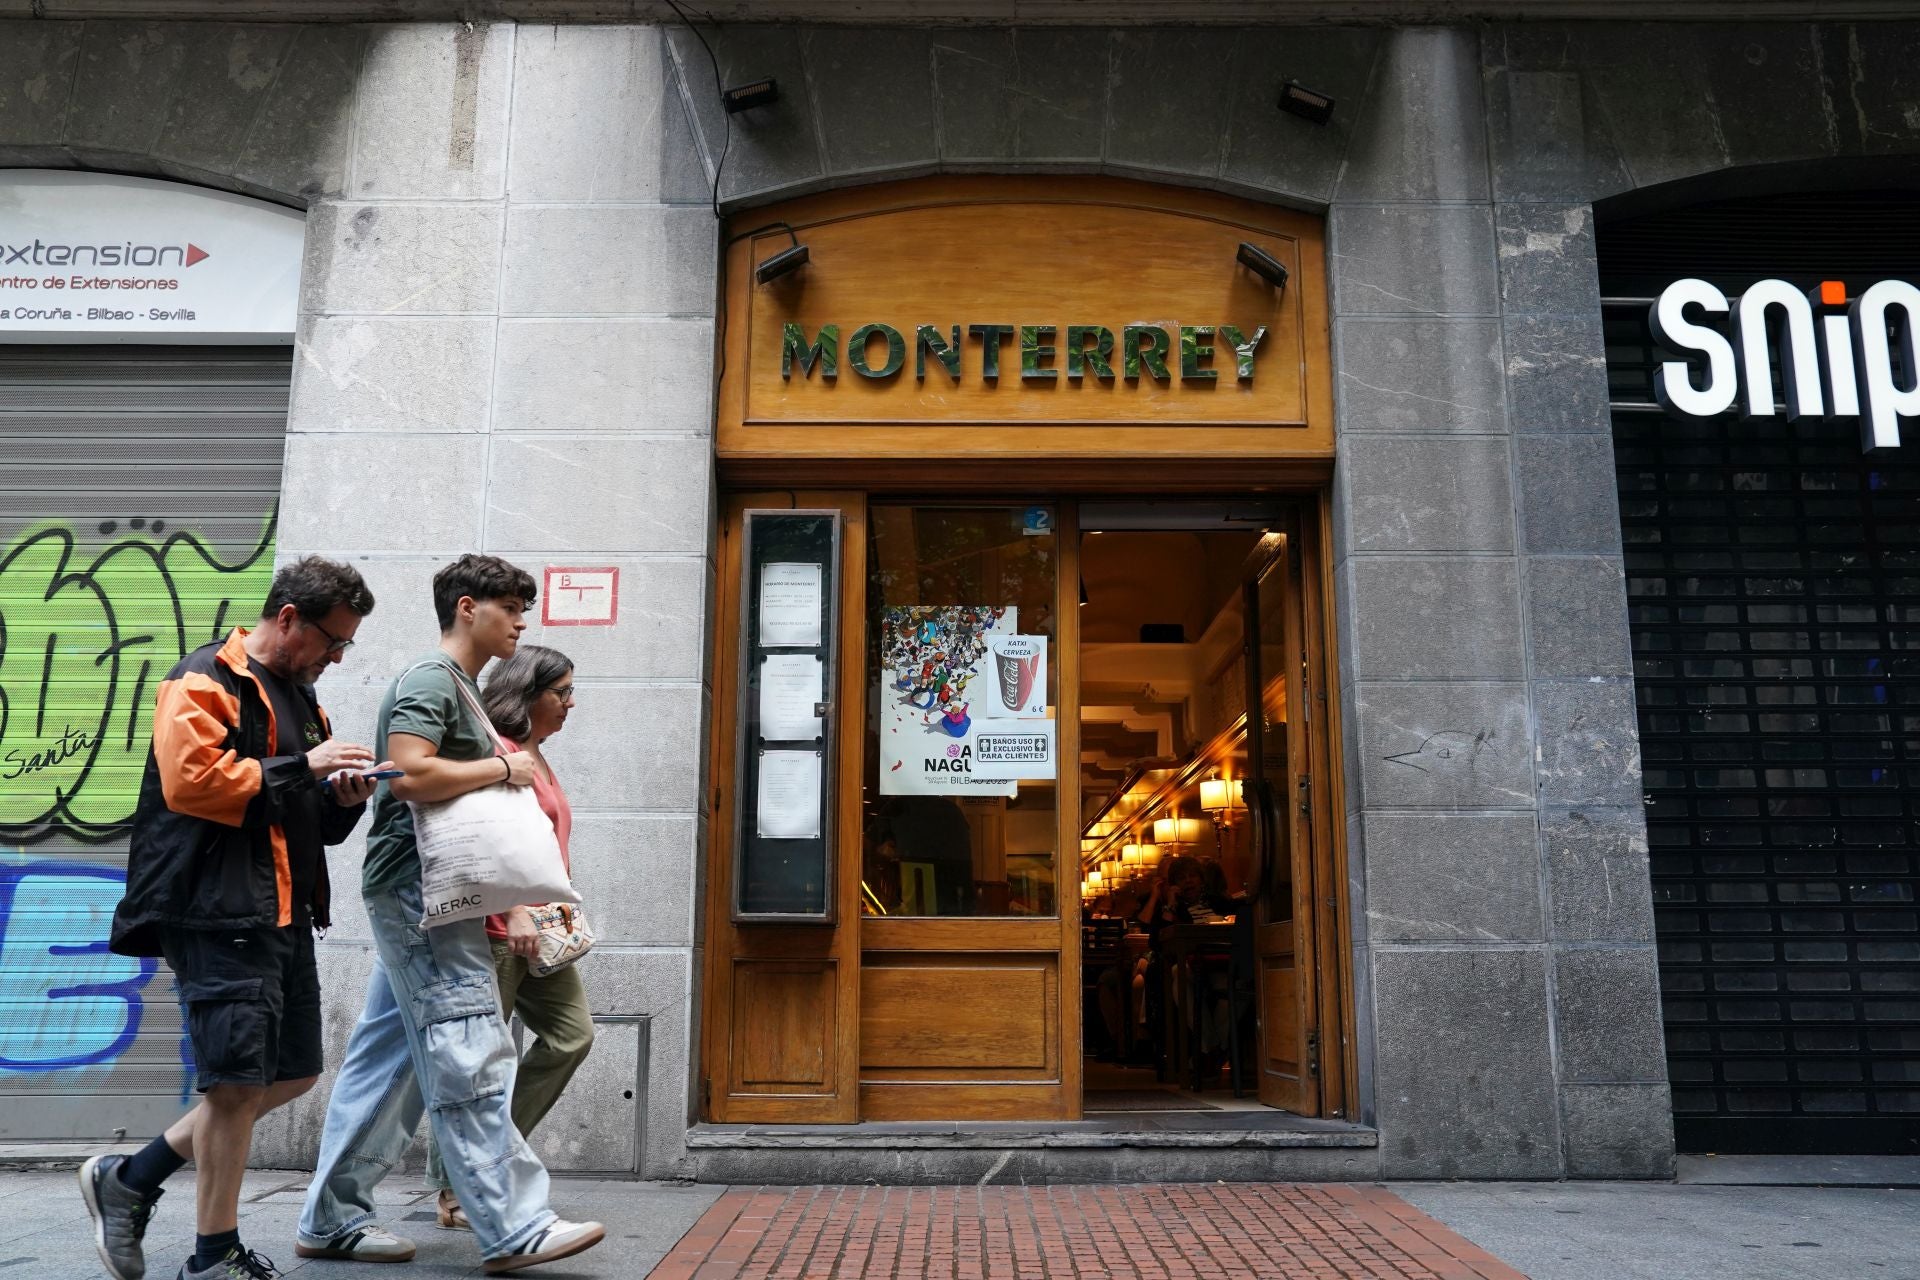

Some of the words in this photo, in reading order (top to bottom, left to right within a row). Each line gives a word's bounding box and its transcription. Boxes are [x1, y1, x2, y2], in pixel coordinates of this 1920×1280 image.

[0, 239, 183, 266] xtension
[43, 276, 65, 289] de
[71, 276, 178, 290] Extensiones
[15, 307, 72, 320] Coruña
[87, 308, 134, 320] Bilbao
[149, 309, 196, 321] Sevilla
[782, 322, 1268, 383] MONTERREY
[992, 737, 1017, 745] BAÑOS
[427, 894, 482, 916] LIERAC
